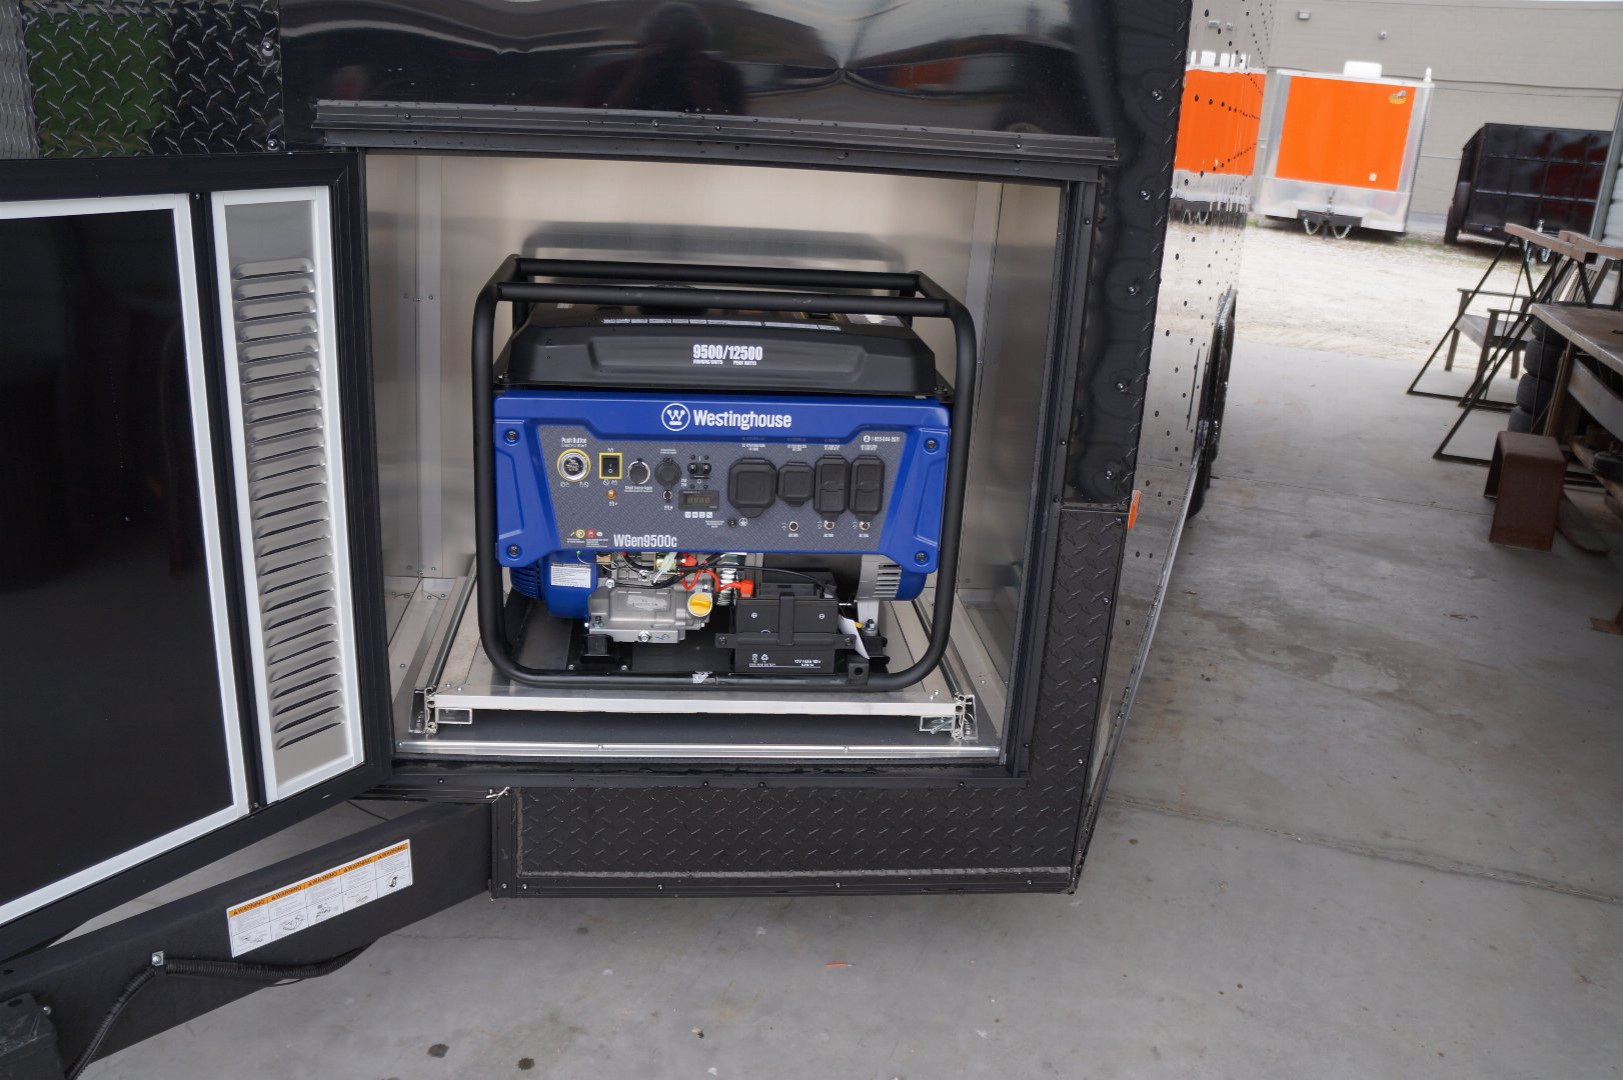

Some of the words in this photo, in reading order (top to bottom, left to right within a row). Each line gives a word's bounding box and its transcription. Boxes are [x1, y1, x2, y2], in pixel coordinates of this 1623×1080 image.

[693, 344, 763, 360] 9500/12500
[693, 409, 792, 430] Westinghouse
[614, 534, 678, 548] WGen9500c
